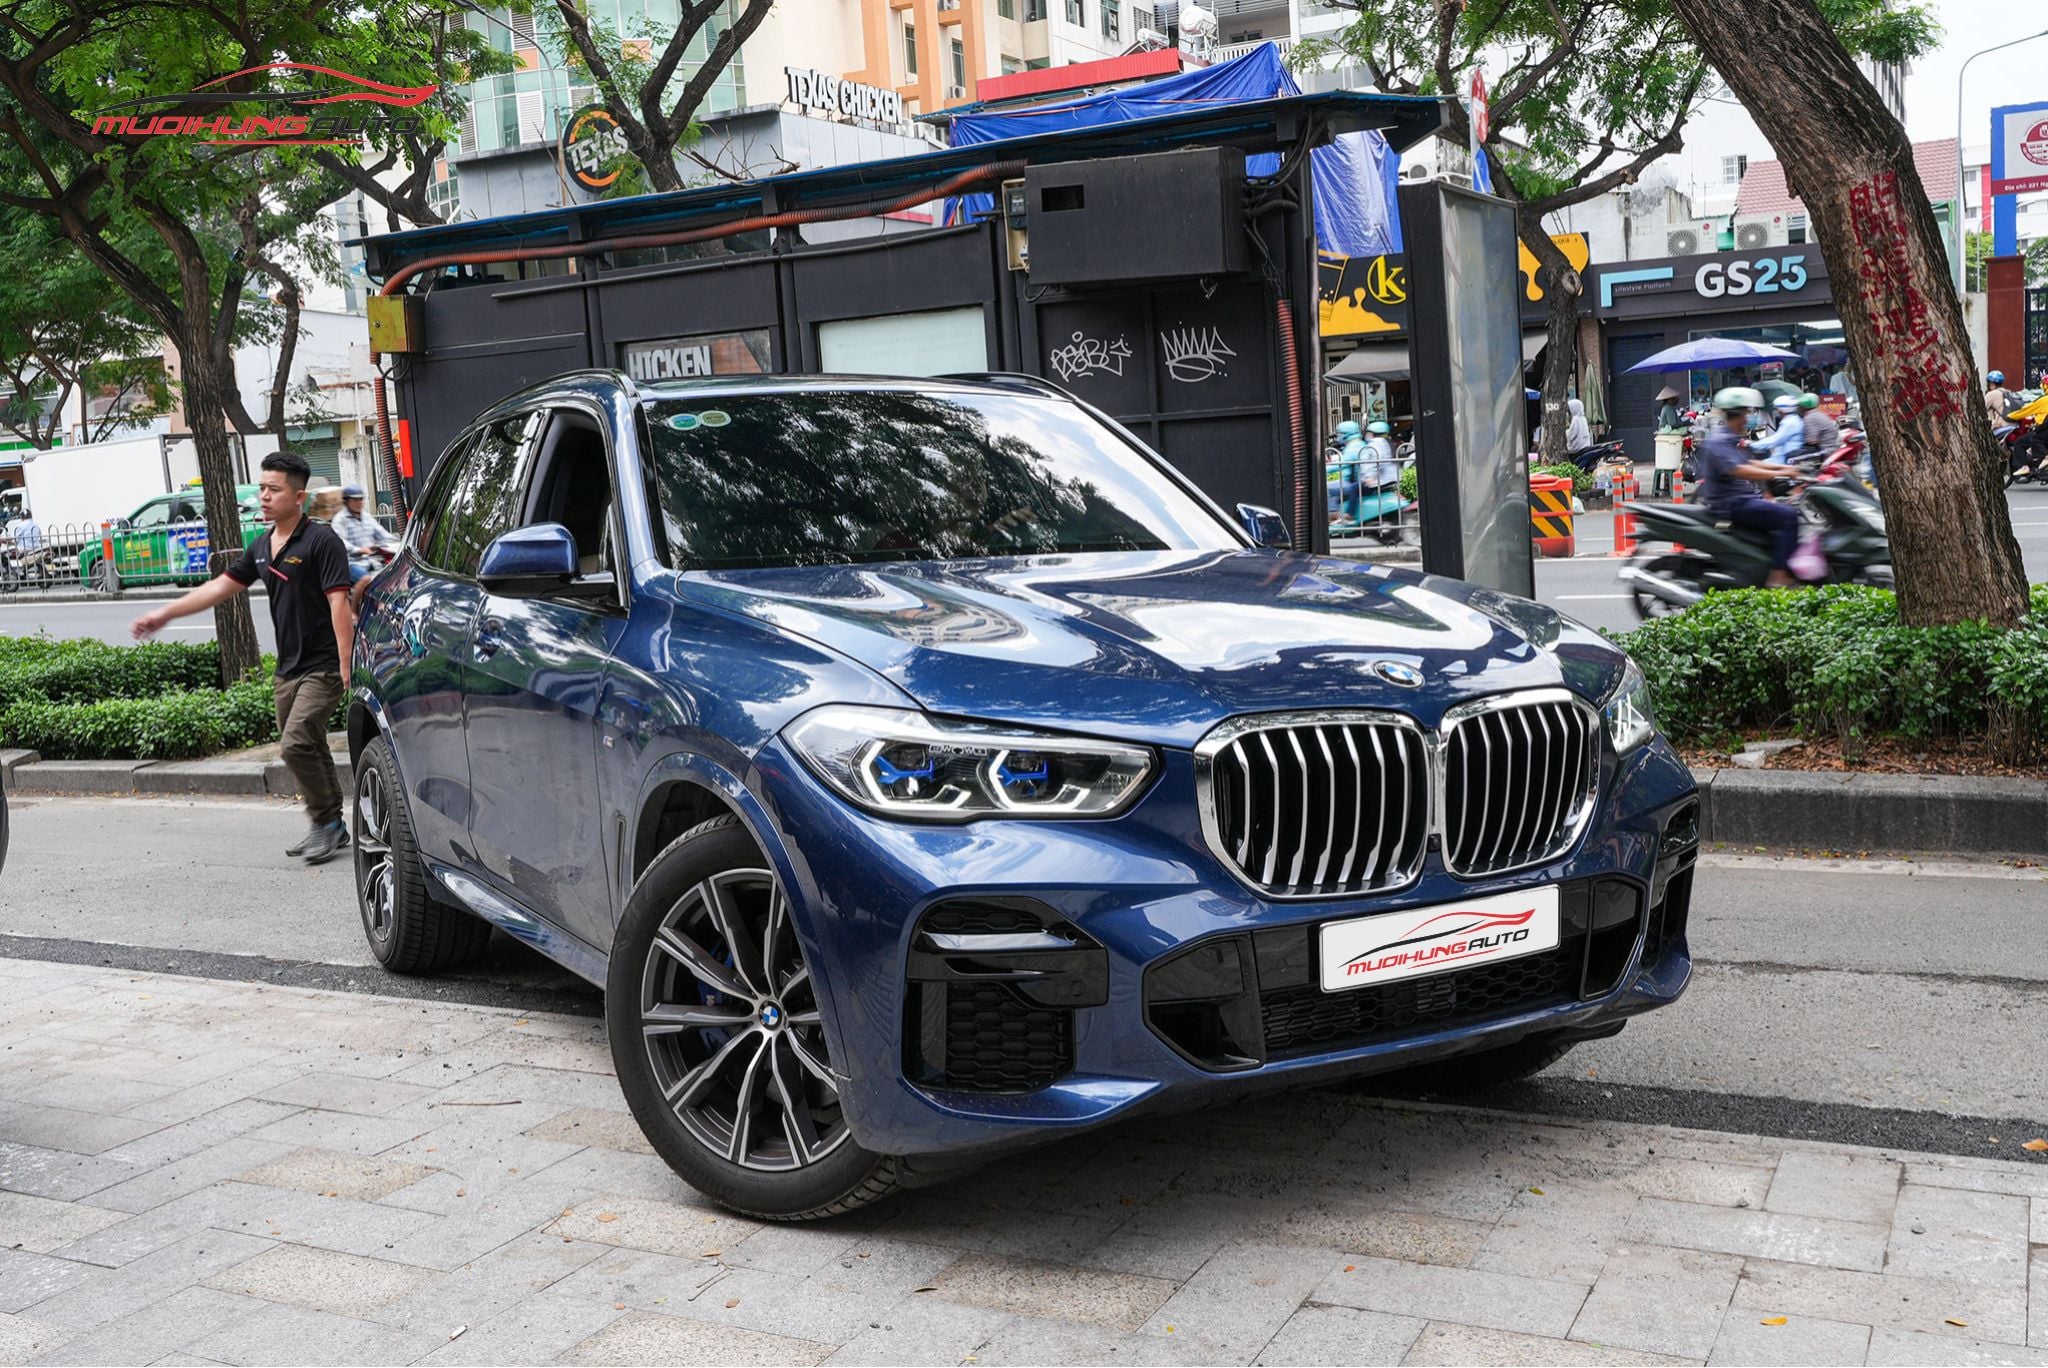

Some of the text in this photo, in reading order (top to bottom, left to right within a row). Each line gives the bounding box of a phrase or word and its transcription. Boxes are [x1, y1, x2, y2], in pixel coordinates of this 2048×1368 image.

[784, 66, 903, 125] TEXAS CHICKEN
[1614, 281, 1672, 293] Lifestyle Platform
[1694, 255, 1807, 298] GS25
[628, 345, 712, 380] HICKEN
[1545, 403, 1560, 412] 130
